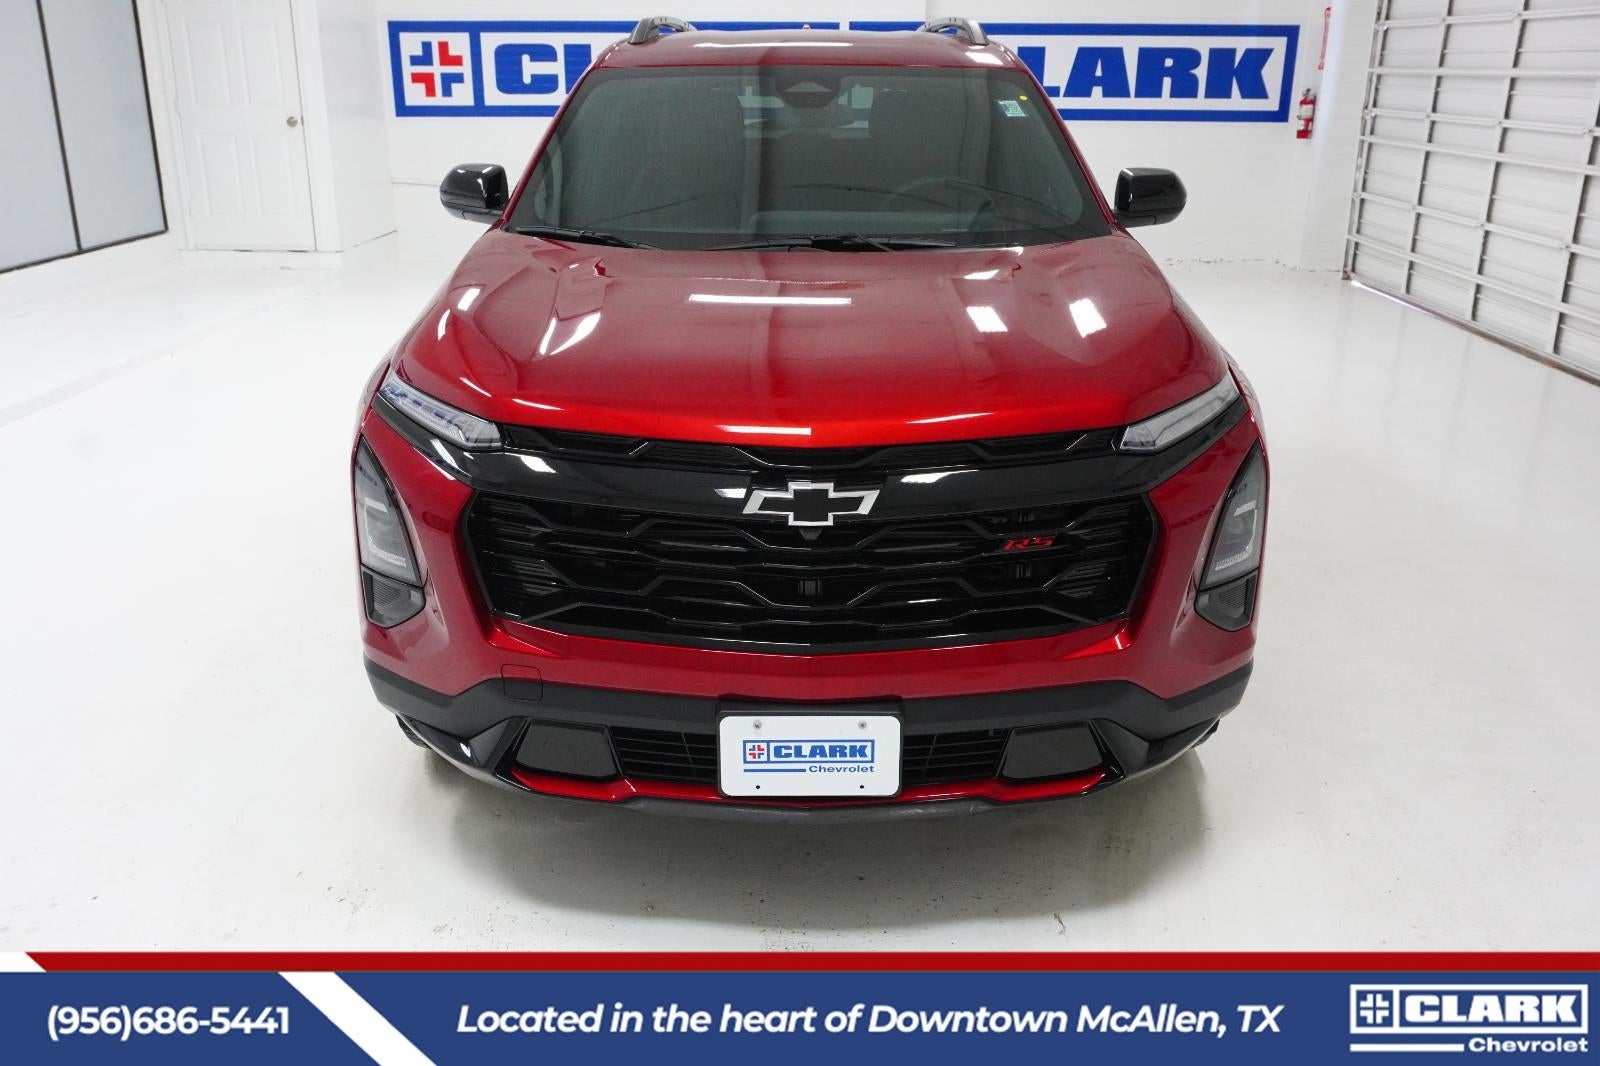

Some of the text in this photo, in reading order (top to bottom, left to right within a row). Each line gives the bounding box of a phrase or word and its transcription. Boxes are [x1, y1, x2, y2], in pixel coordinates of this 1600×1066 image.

[1002, 535, 1055, 552] RS
[773, 744, 868, 759] CLARK
[808, 764, 875, 773] Chevrolet
